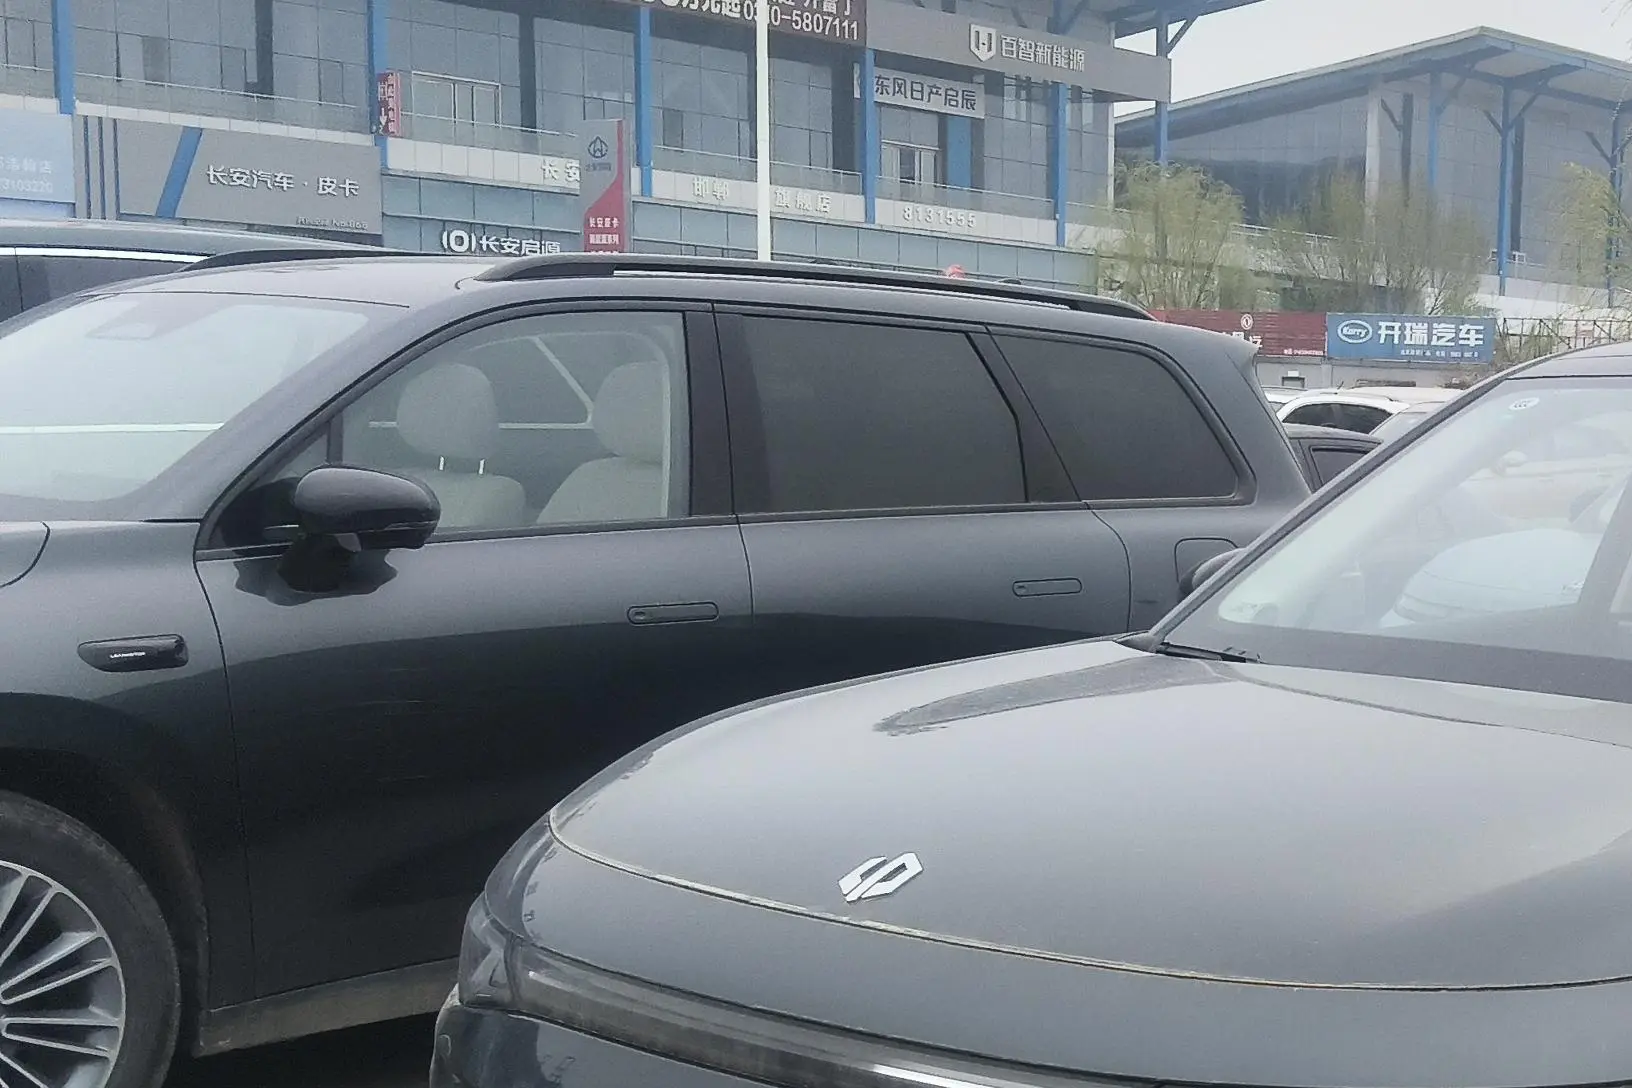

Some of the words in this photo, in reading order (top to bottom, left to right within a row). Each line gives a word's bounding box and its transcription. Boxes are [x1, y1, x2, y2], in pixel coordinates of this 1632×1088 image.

[743, 0, 858, 40] 00-5807111
[1000, 35, 1085, 72] 百智新能源
[875, 74, 976, 111] 东风日产启辰
[903, 205, 977, 228] 8131555
[480, 235, 560, 256] 长安启源
[1378, 321, 1484, 347] 开瑞汽车
